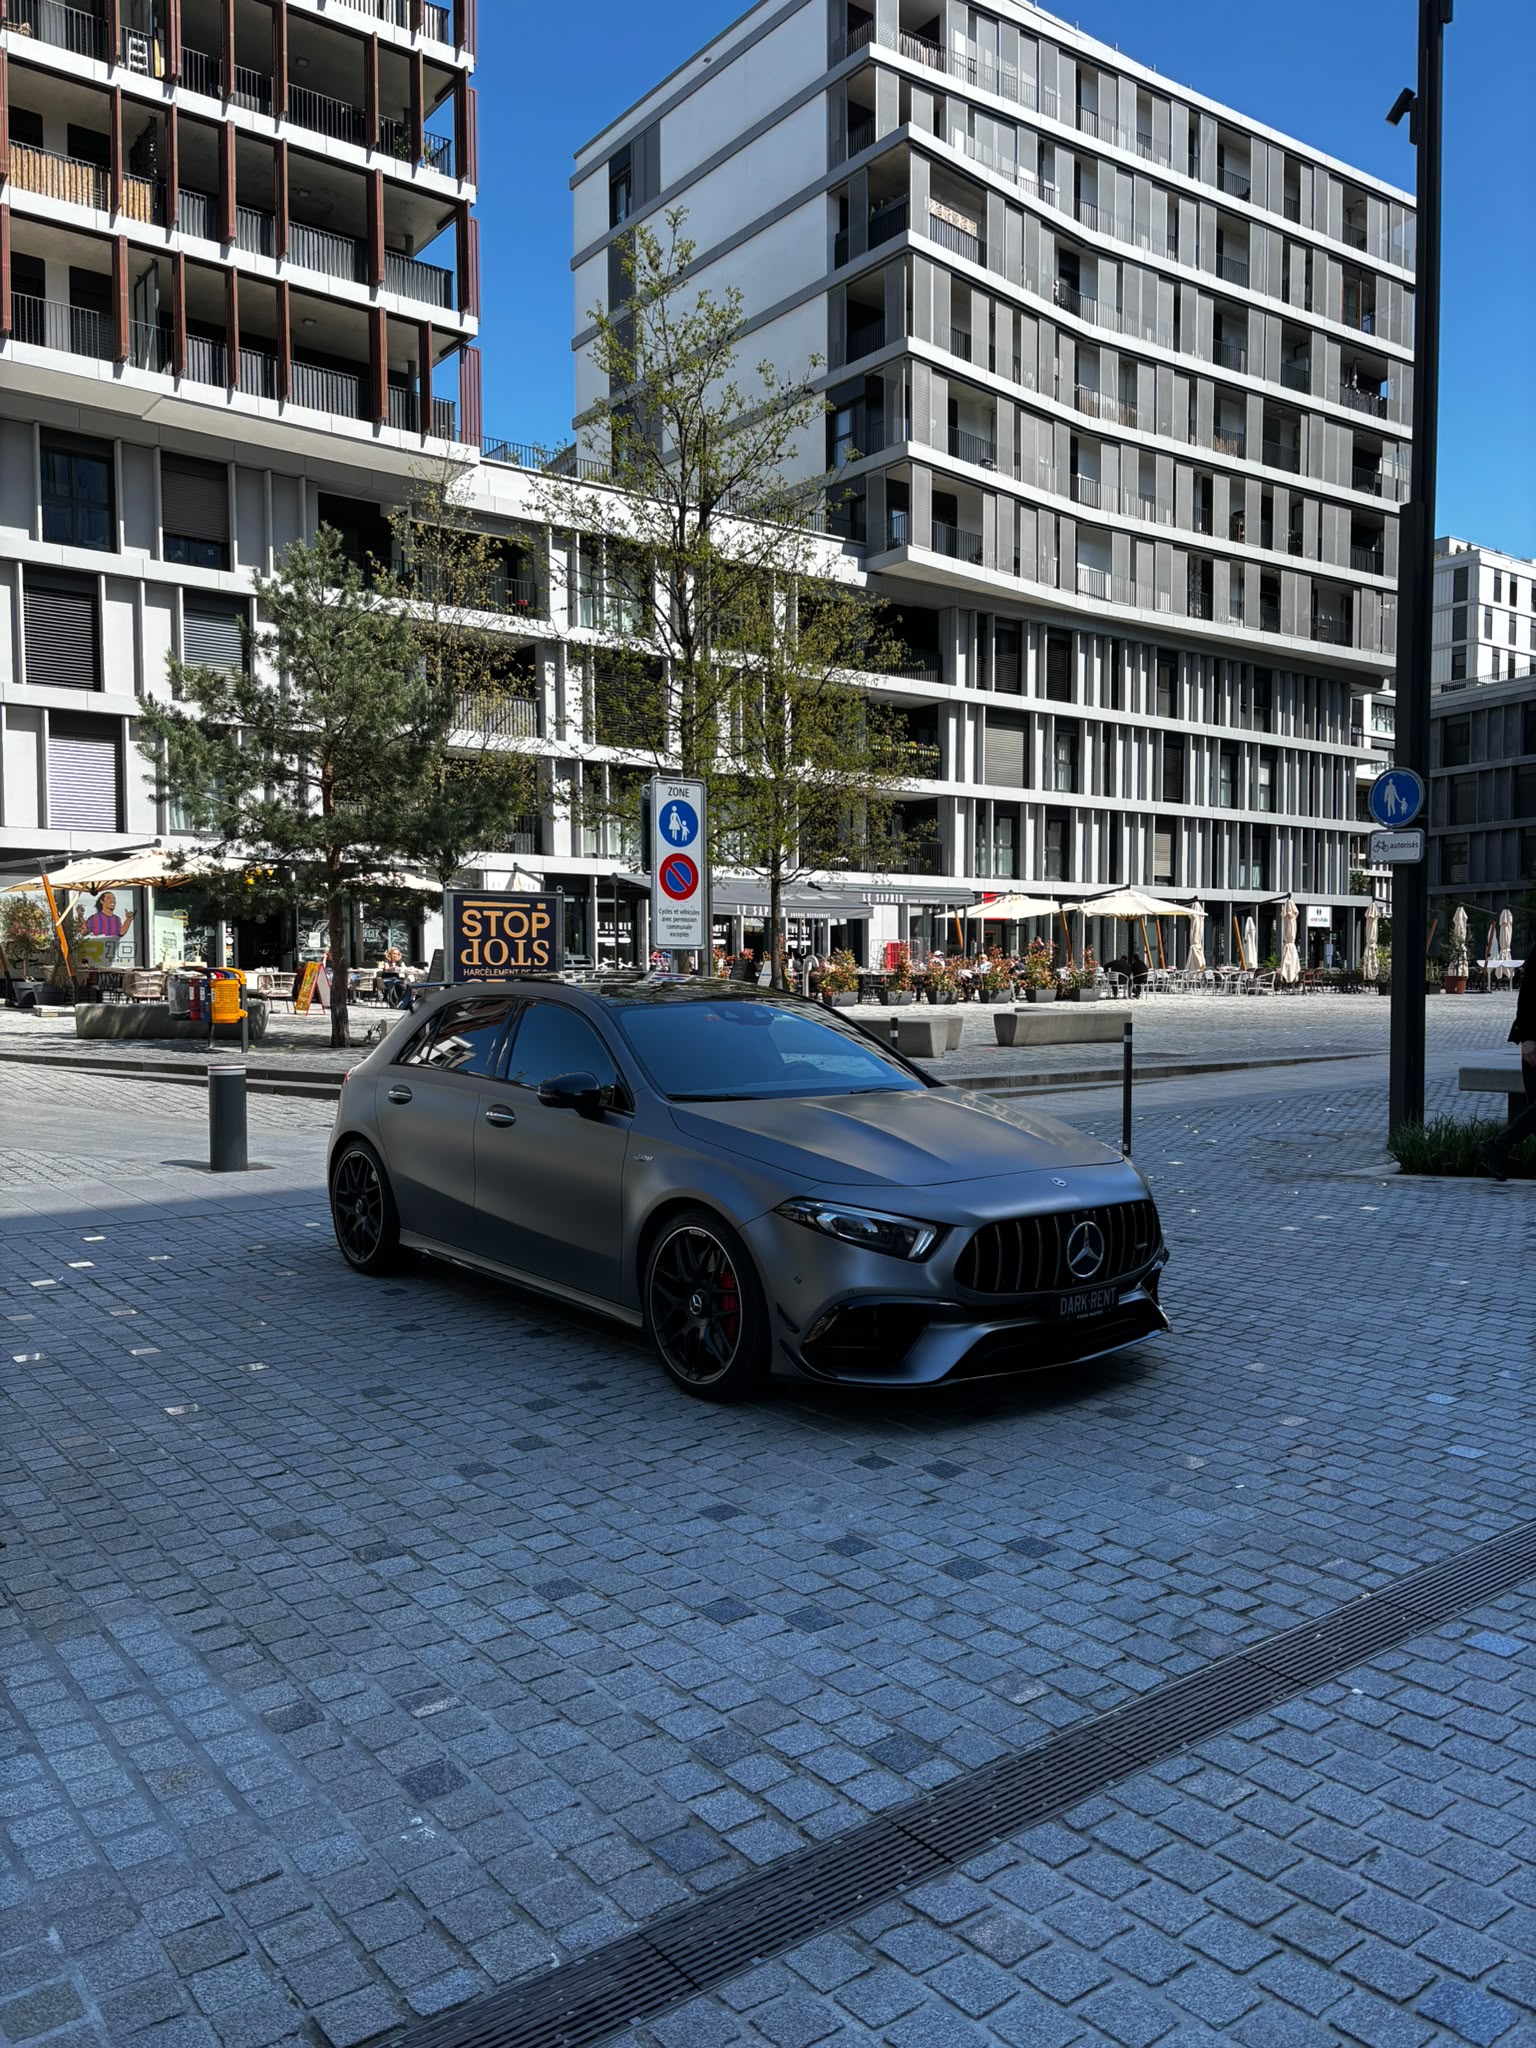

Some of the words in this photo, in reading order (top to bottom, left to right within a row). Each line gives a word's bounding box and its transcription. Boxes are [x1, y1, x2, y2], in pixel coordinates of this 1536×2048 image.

[667, 786, 690, 798] ZONE
[1390, 841, 1419, 849] autorisés
[658, 907, 673, 915] Cycles
[736, 904, 747, 915] LE
[753, 905, 787, 917] SAPR
[461, 909, 551, 938] STOP
